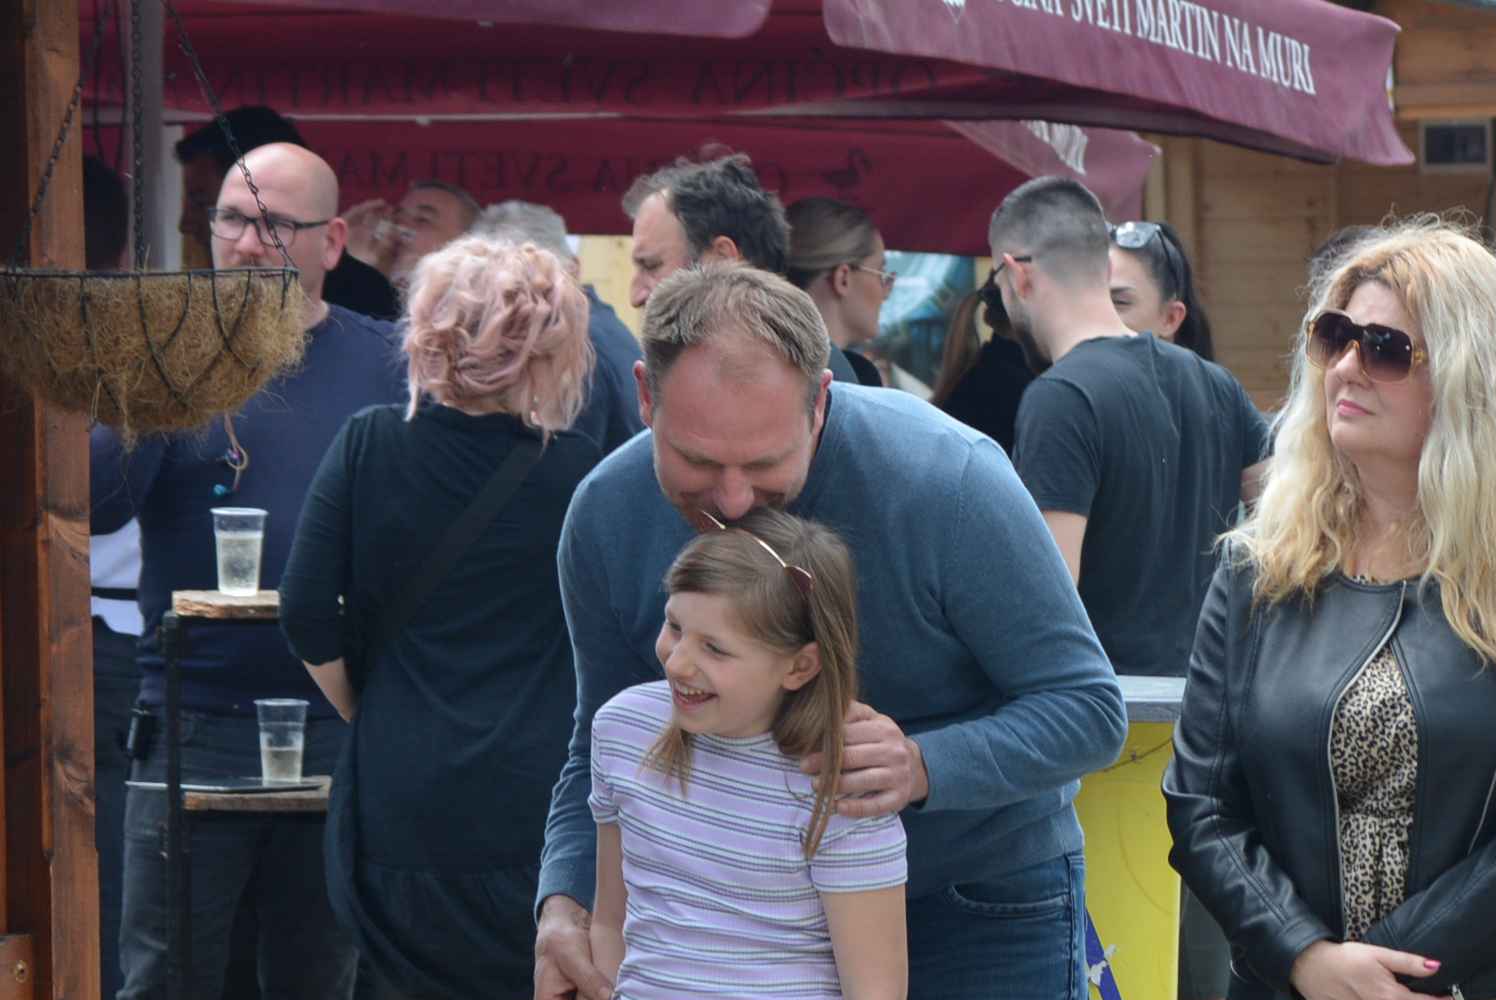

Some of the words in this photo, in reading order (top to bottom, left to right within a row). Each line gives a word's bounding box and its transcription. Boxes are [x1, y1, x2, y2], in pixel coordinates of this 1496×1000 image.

[1137, 0, 1221, 63] MARTIN
[1222, 15, 1257, 76] NA
[1257, 26, 1317, 95] MURI
